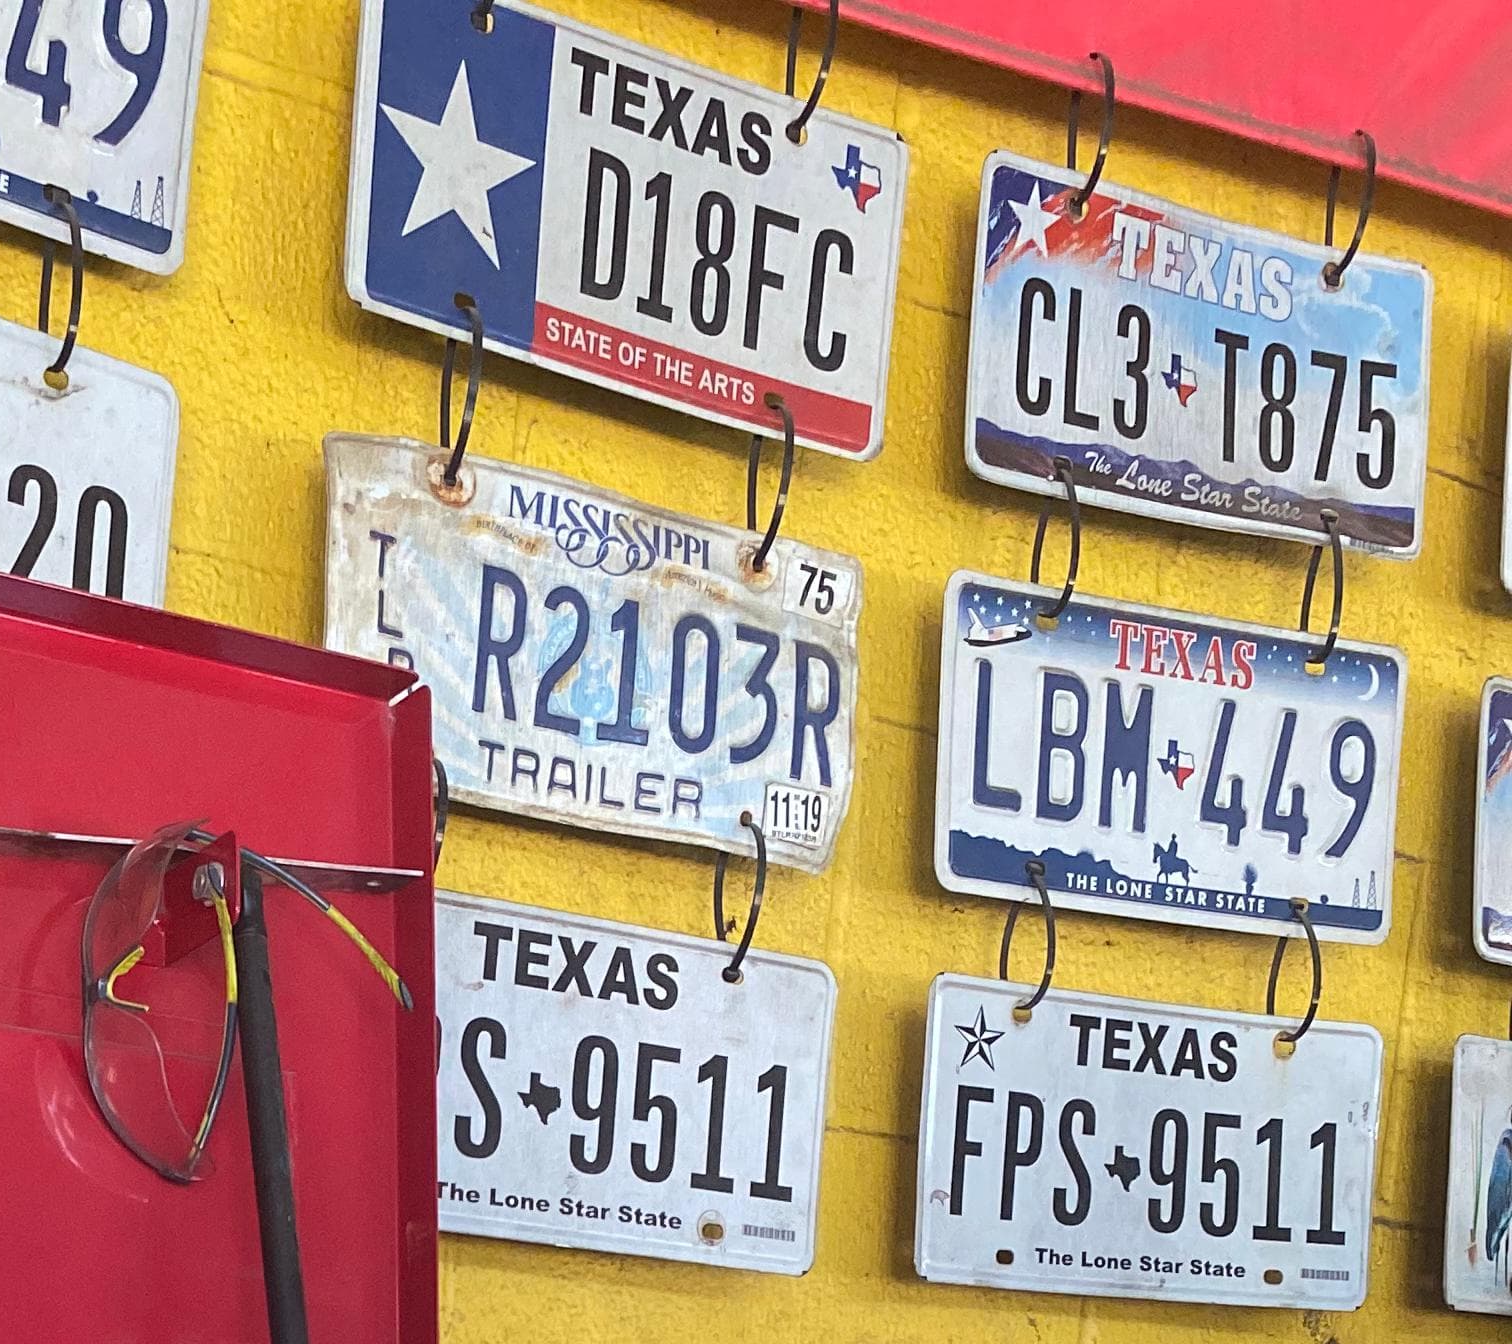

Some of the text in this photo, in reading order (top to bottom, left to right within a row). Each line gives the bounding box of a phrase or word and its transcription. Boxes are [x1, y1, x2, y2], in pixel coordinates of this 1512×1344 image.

[570, 47, 772, 175] TEXAS
[581, 147, 854, 372] D18FC
[1112, 210, 1295, 322] TEXAS
[545, 318, 755, 405] STATE OF THE ARTS
[1015, 278, 1397, 490] CL3 T875
[508, 484, 710, 576] MISSISSIPPI
[1084, 451, 1303, 522] The Lone Star State
[799, 564, 837, 615] 75
[472, 564, 840, 786] R2103R
[1110, 619, 1257, 690] TEXAS
[479, 740, 703, 819] TRAILER
[973, 659, 1376, 857] LBM 449
[1066, 873, 1266, 914] THE LONE STAR STATE
[474, 921, 679, 1010] TEXAS
[1069, 1014, 1238, 1082] TEXAS
[569, 1035, 792, 1202] 9511
[436, 1182, 681, 1229] The Lone Star State
[950, 1085, 1346, 1246] FPS 9511
[1035, 1248, 1245, 1278] The Lone Star State
